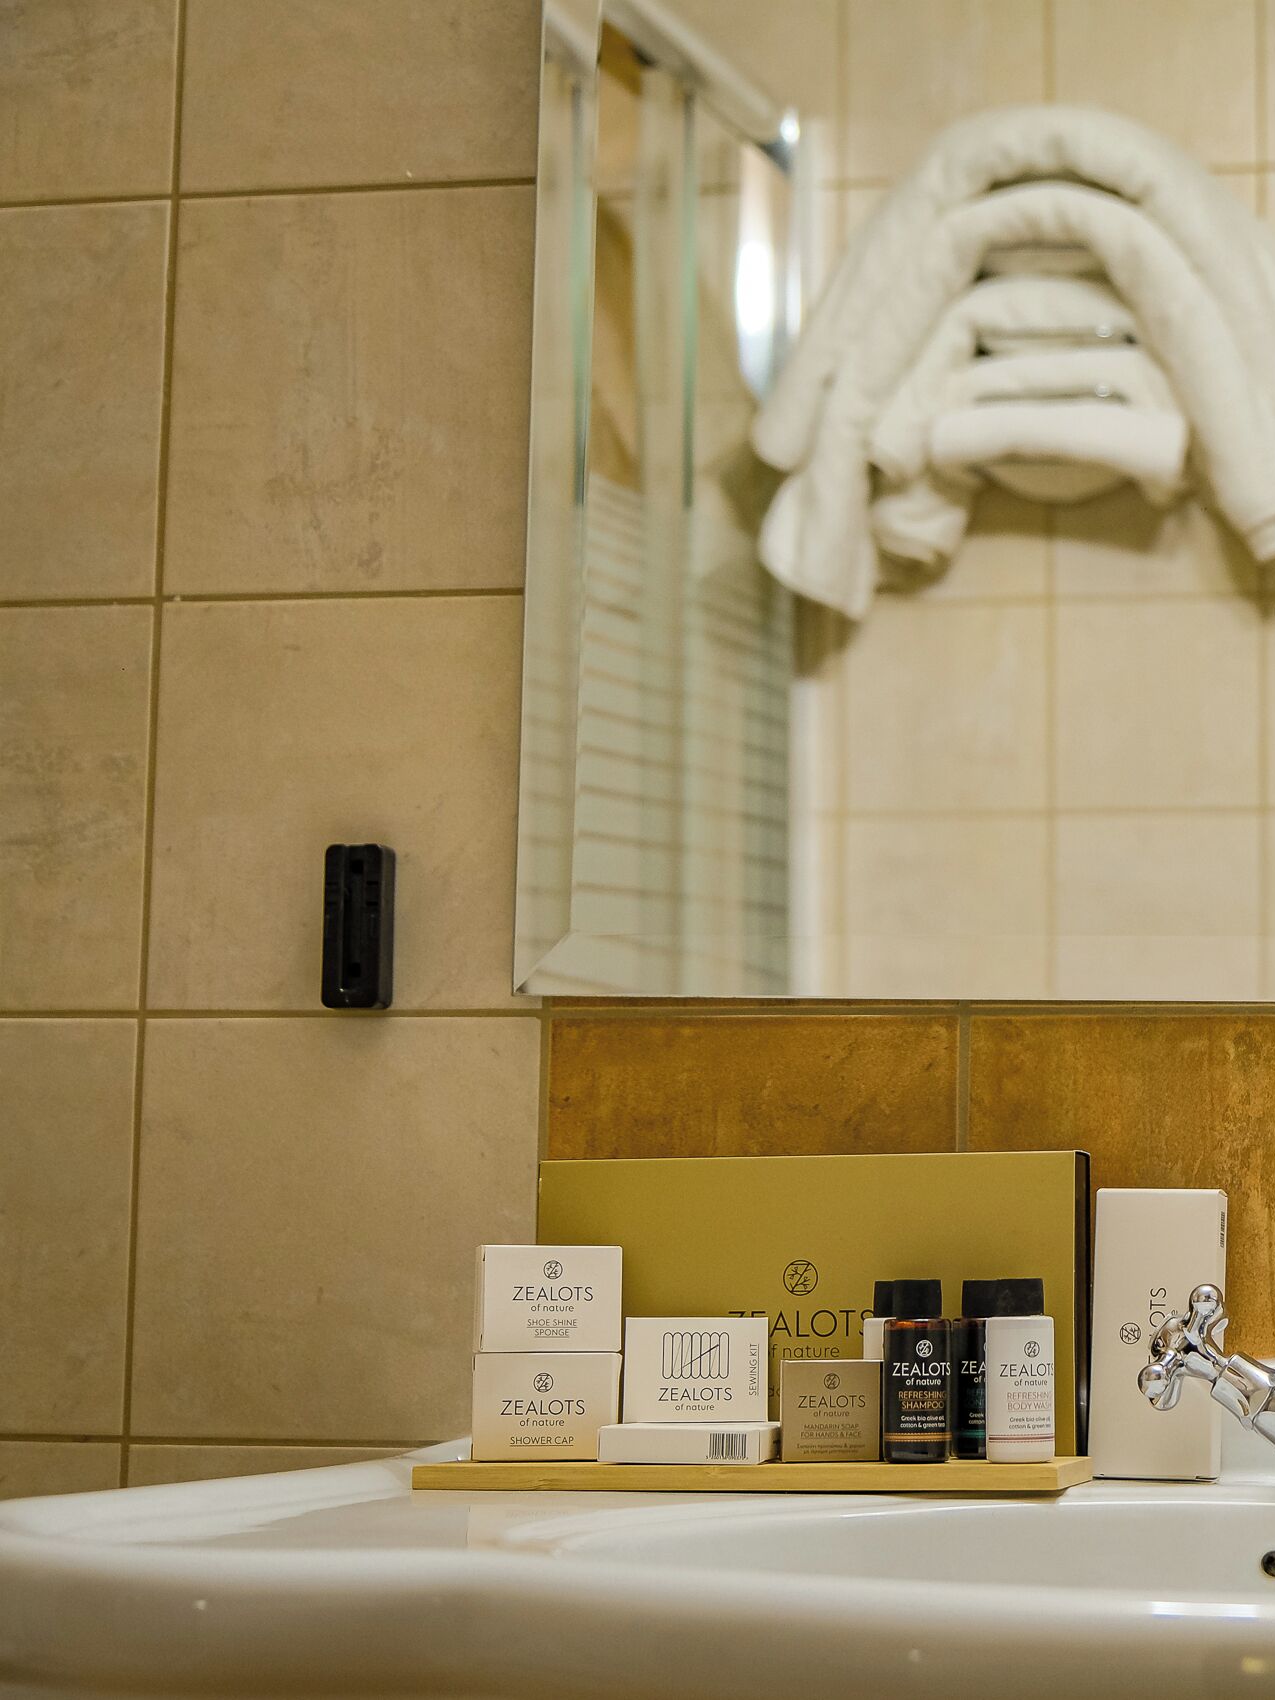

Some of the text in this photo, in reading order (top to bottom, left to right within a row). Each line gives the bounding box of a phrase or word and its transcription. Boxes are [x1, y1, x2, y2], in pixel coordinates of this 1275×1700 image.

[512, 1286, 594, 1301] ZEALOTS
[531, 1304, 540, 1312] of
[527, 1318, 578, 1327] SHOE SHINE
[534, 1328, 570, 1336] SPONGE
[782, 1346, 840, 1358] nature
[892, 1362, 951, 1376] ZEALOTS
[999, 1363, 1054, 1377] ZEALOTS
[749, 1359, 757, 1396] SEWING
[905, 1378, 942, 1386] of nature
[1014, 1379, 1023, 1387] of
[658, 1387, 733, 1401] ZEALOTS
[898, 1391, 947, 1399] REFRESHING
[797, 1395, 866, 1409] ZEALOTS
[901, 1401, 944, 1409] SHAMPOO
[1007, 1402, 1033, 1410] BODY
[500, 1399, 585, 1416] ZEALOTS
[519, 1418, 565, 1427] of nature
[510, 1436, 574, 1445] SHOWER CAP
